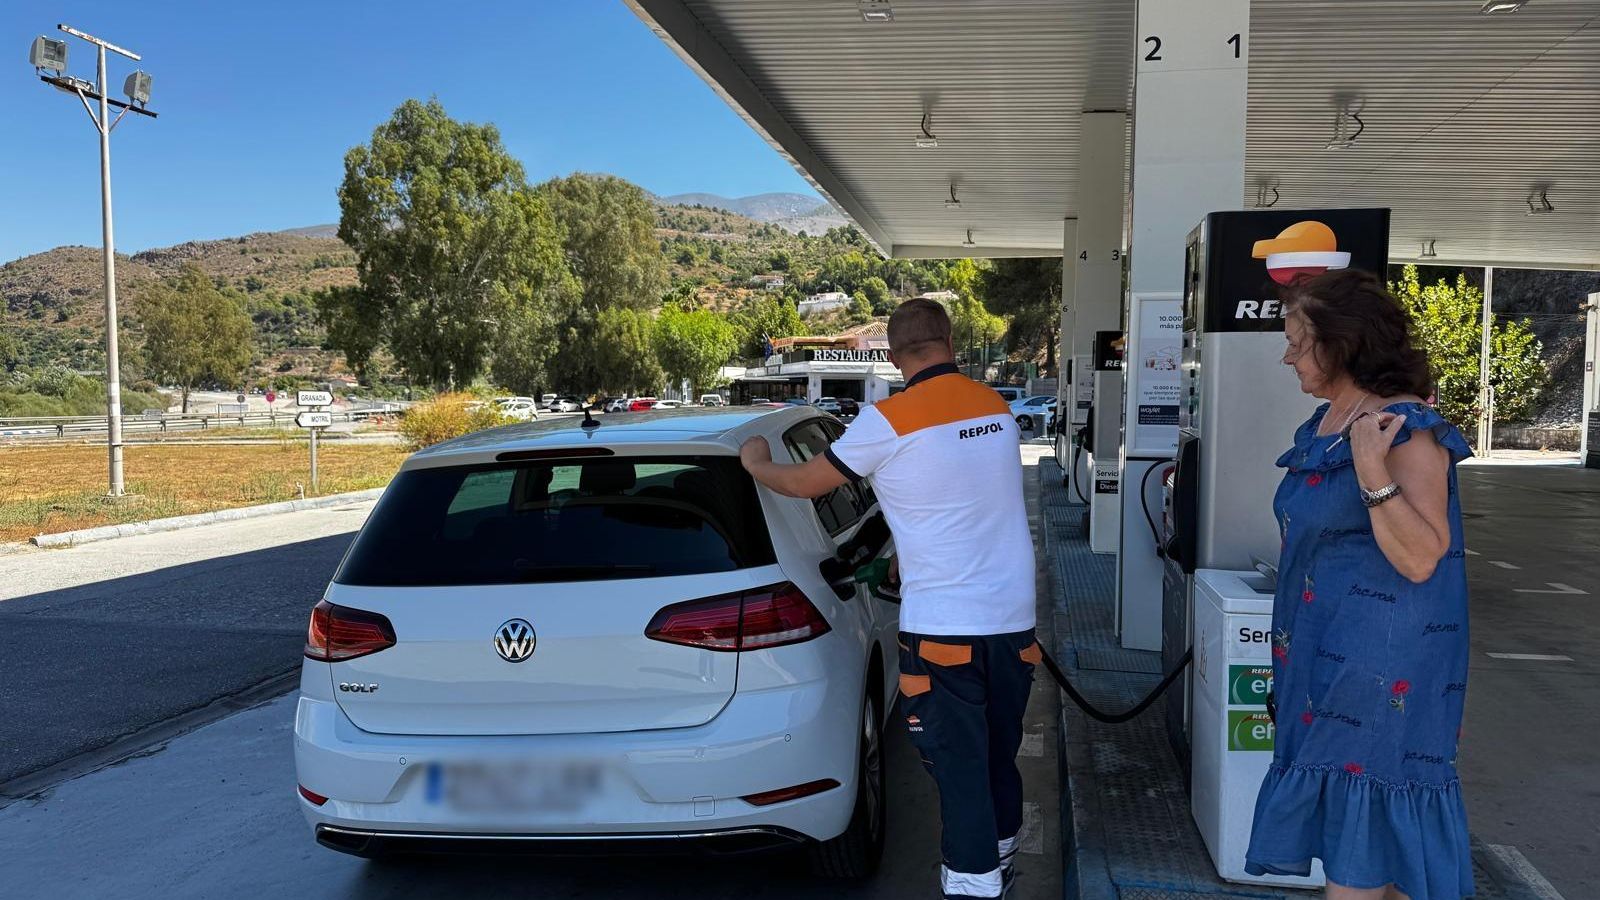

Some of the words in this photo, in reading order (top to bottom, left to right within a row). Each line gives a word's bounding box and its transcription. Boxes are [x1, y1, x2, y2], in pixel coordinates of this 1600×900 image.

[1144, 36, 1162, 61] 2
[1227, 33, 1241, 59] 1
[1080, 250, 1088, 260] 4
[1112, 249, 1120, 261] 3
[1062, 305, 1069, 313] 6
[300, 394, 327, 402] GRANADA
[311, 415, 329, 423] MOTRIL
[959, 422, 1004, 440] REPSOL
[339, 682, 379, 693] GOLF
